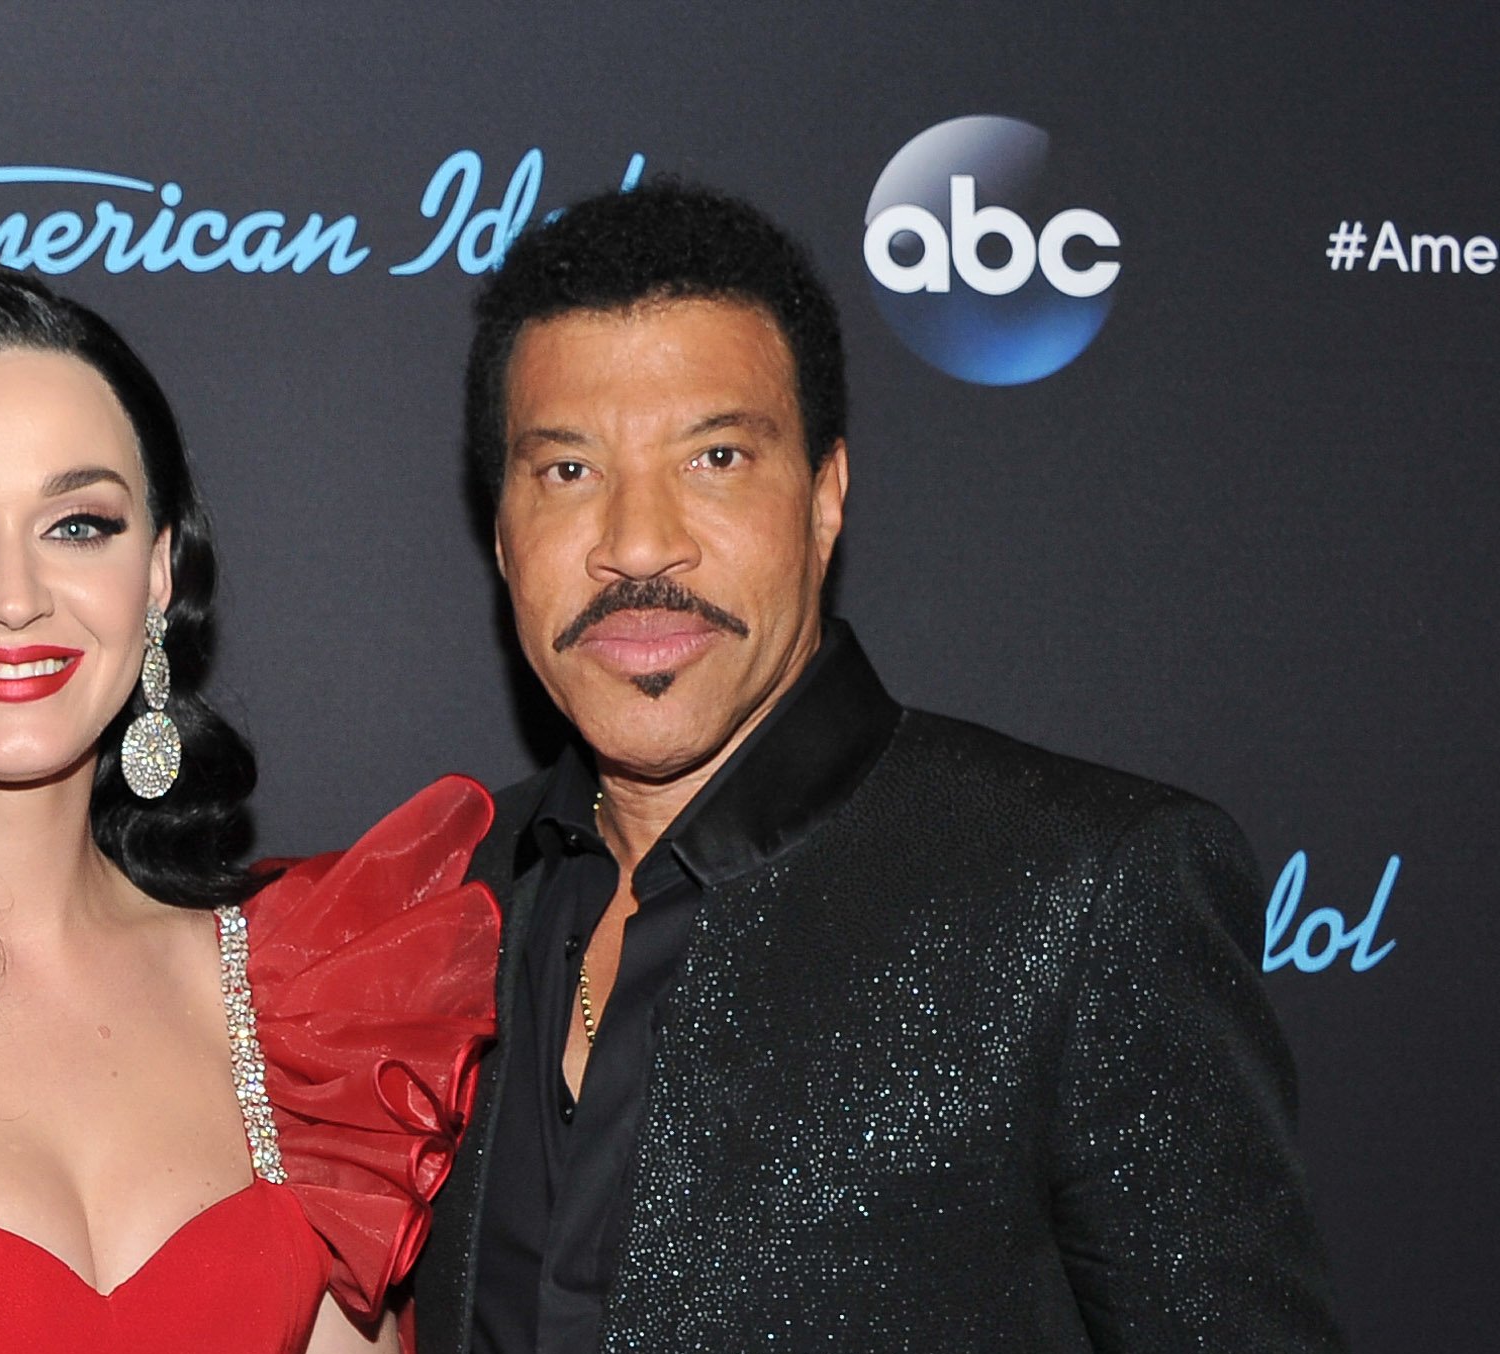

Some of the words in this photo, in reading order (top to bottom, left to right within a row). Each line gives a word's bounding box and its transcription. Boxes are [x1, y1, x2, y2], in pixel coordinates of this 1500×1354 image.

[389, 147, 646, 276] Id
[863, 175, 1121, 298] abc
[1325, 220, 1499, 275] #Ame
